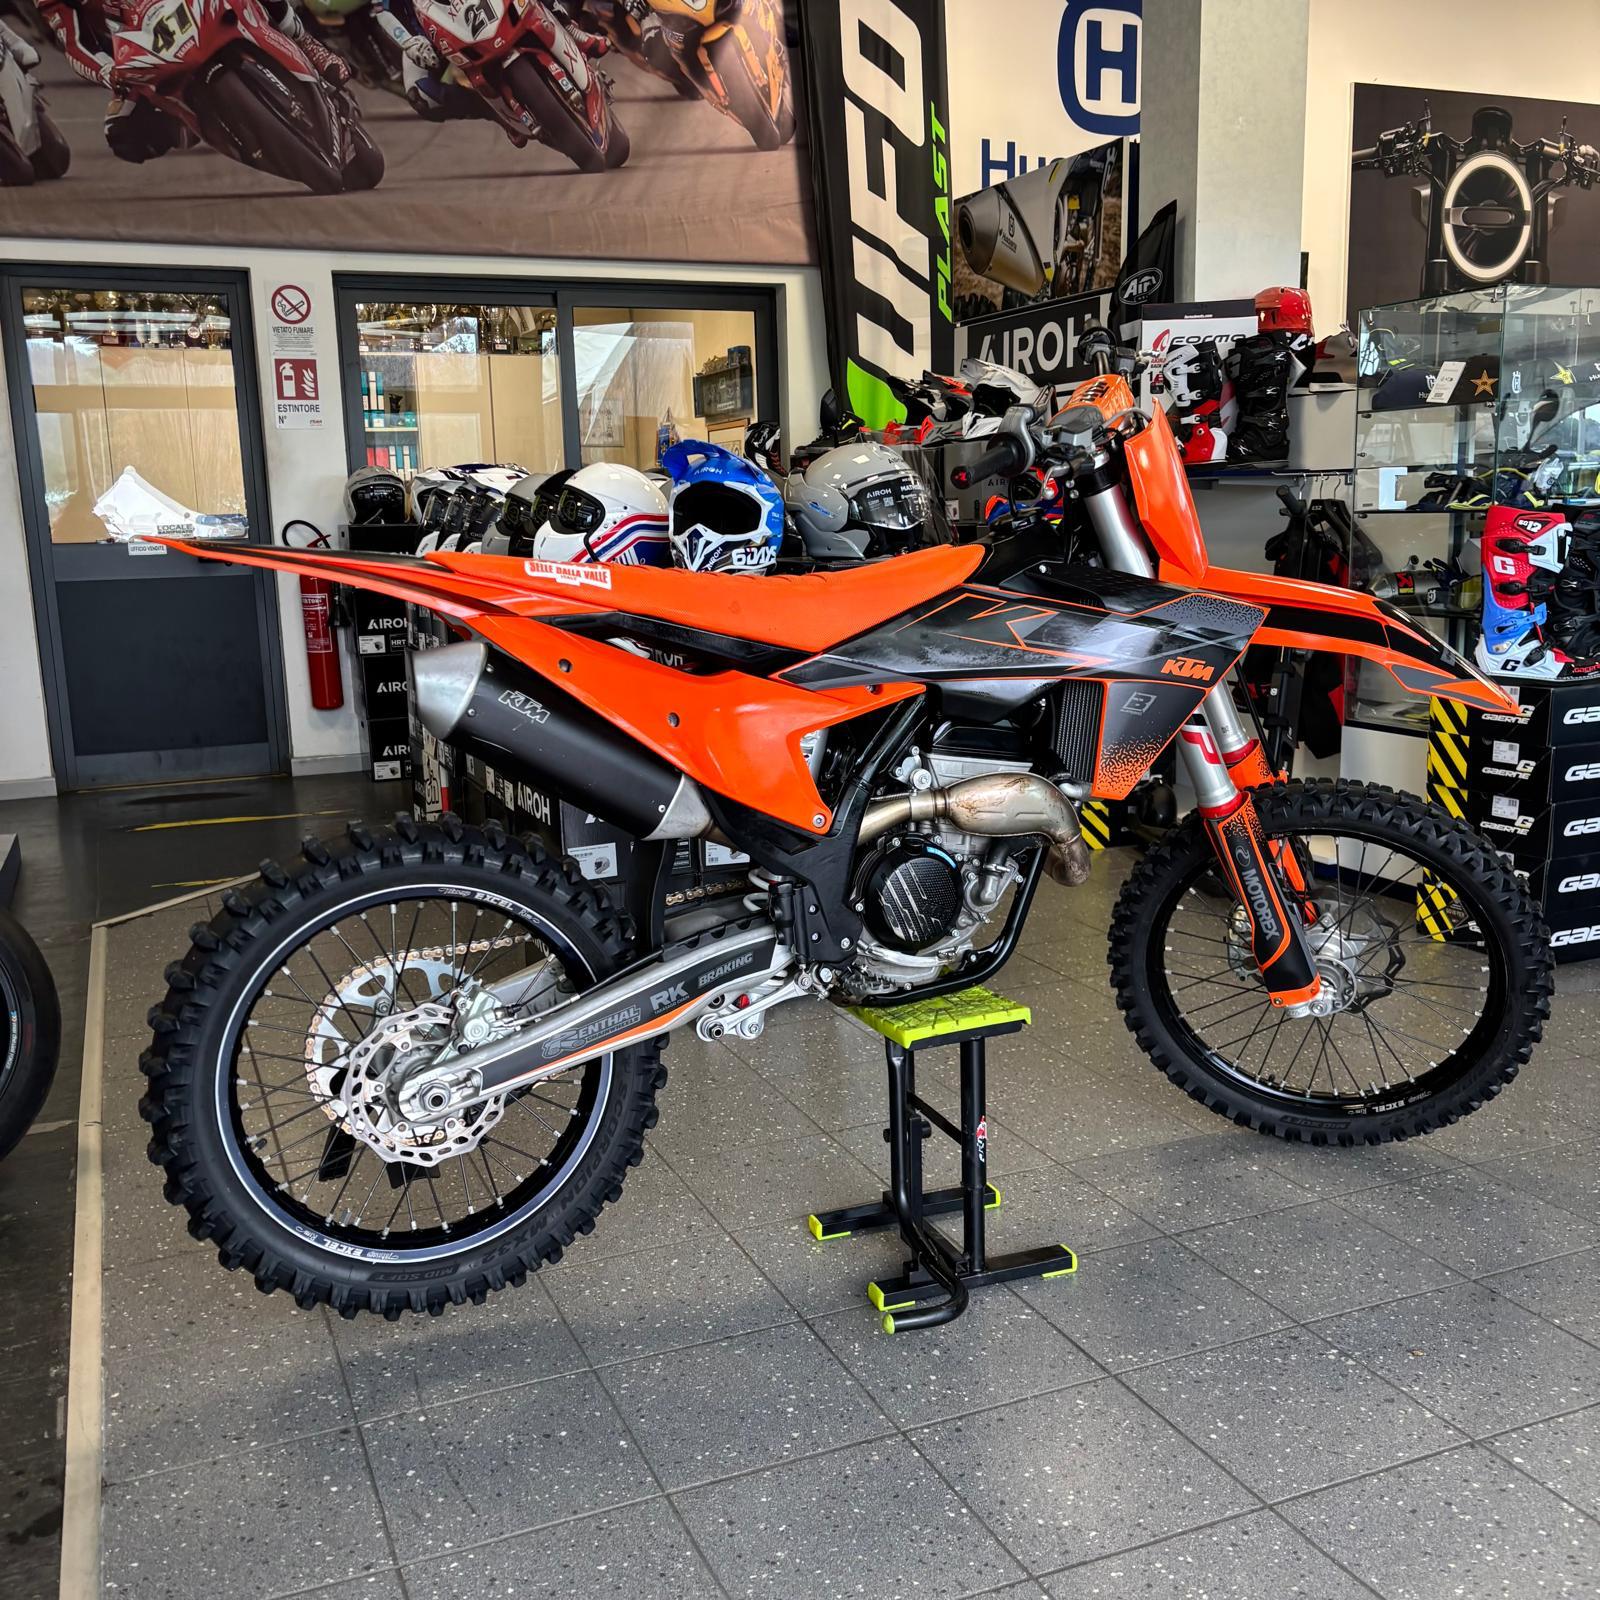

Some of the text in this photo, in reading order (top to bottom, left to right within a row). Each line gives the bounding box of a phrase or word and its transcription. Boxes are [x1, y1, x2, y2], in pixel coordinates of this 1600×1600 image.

[152, 2, 193, 55] 41
[464, 0, 498, 40] 21
[839, 0, 932, 374] UFO
[930, 100, 953, 324] PLAST
[272, 326, 315, 334] VIETATO FUMARE
[277, 404, 320, 413] ESTINTORE
[278, 415, 287, 425] N°
[866, 487, 892, 499] AIROH
[157, 523, 193, 531] LOCALE
[529, 561, 608, 584] SELLE DALLA VALLE
[1161, 656, 1215, 681] KTM
[498, 690, 551, 724] KTM
[517, 781, 551, 826] AIROH
[474, 892, 514, 911] EXCEL
[1241, 868, 1280, 941] MOTOREX
[698, 953, 754, 988] BRAKING
[650, 980, 689, 1010] RK
[1372, 1100, 1405, 1113] EXCEL
[322, 1238, 364, 1258] EXCEL
